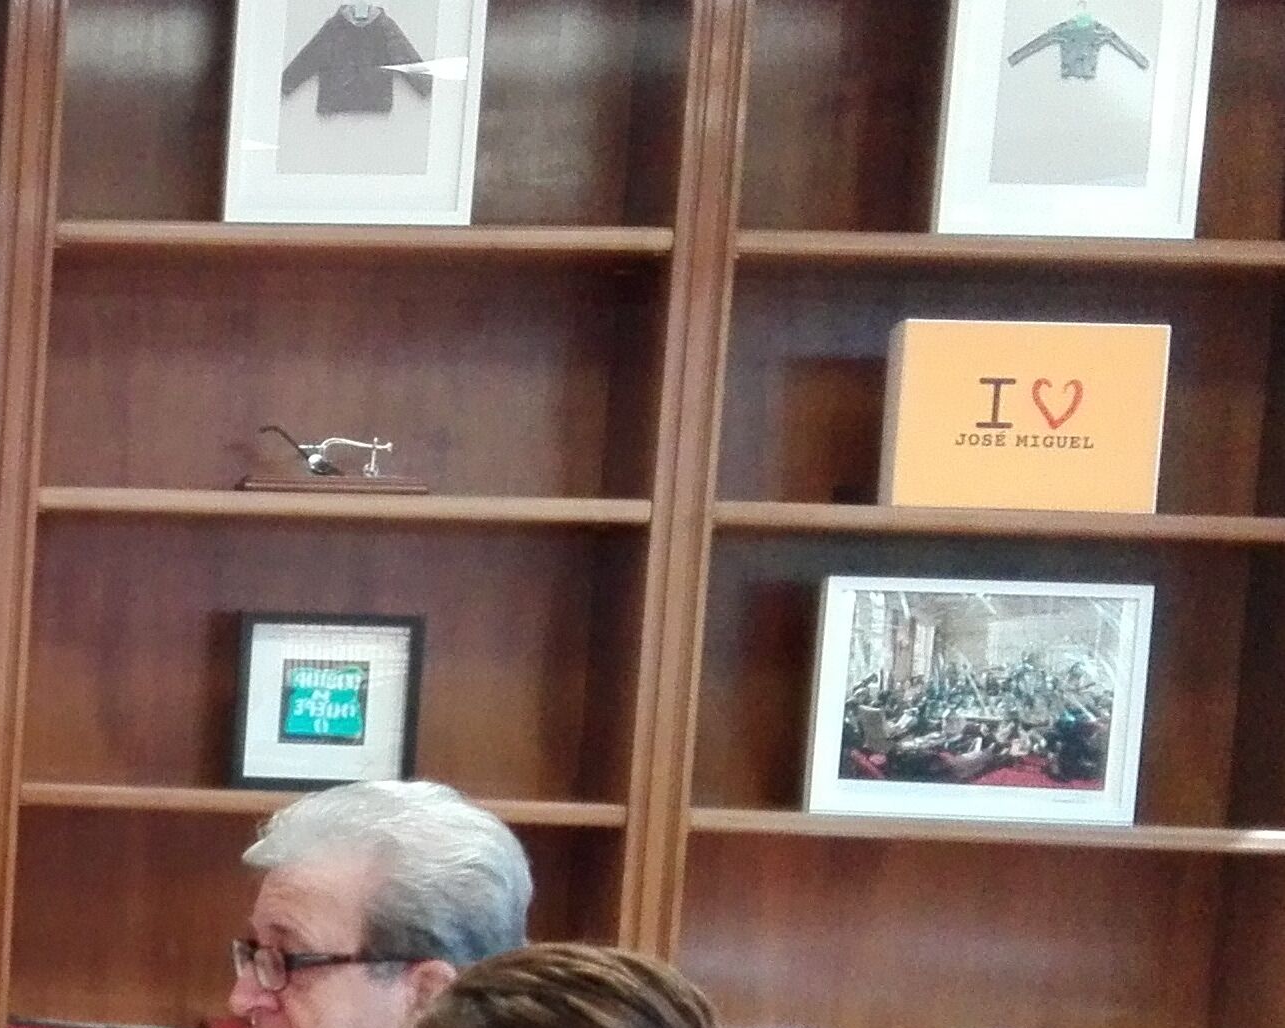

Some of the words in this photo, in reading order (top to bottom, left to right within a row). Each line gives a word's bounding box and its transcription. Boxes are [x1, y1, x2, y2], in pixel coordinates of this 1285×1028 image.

[976, 378, 1017, 429] I
[955, 431, 1007, 447] JOSÉ
[1015, 435, 1094, 449] MIGUEL
